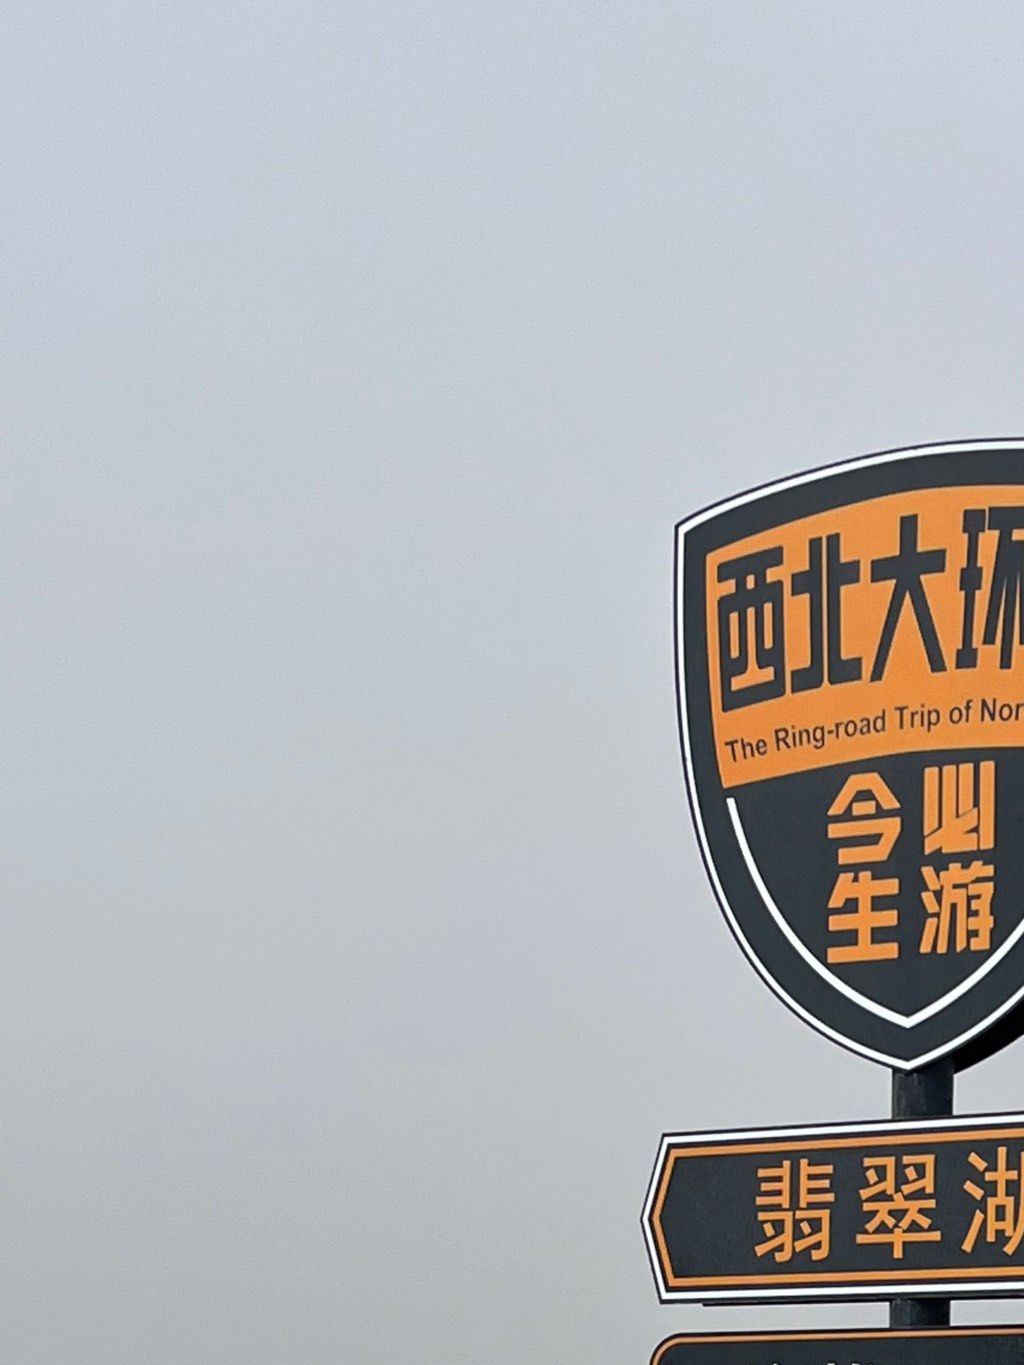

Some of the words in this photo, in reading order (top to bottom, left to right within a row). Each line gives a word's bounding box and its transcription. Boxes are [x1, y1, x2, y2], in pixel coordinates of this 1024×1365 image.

[724, 738, 768, 763] The
[774, 709, 887, 750] Ring-road
[894, 703, 941, 733] Trip
[949, 698, 974, 724] of
